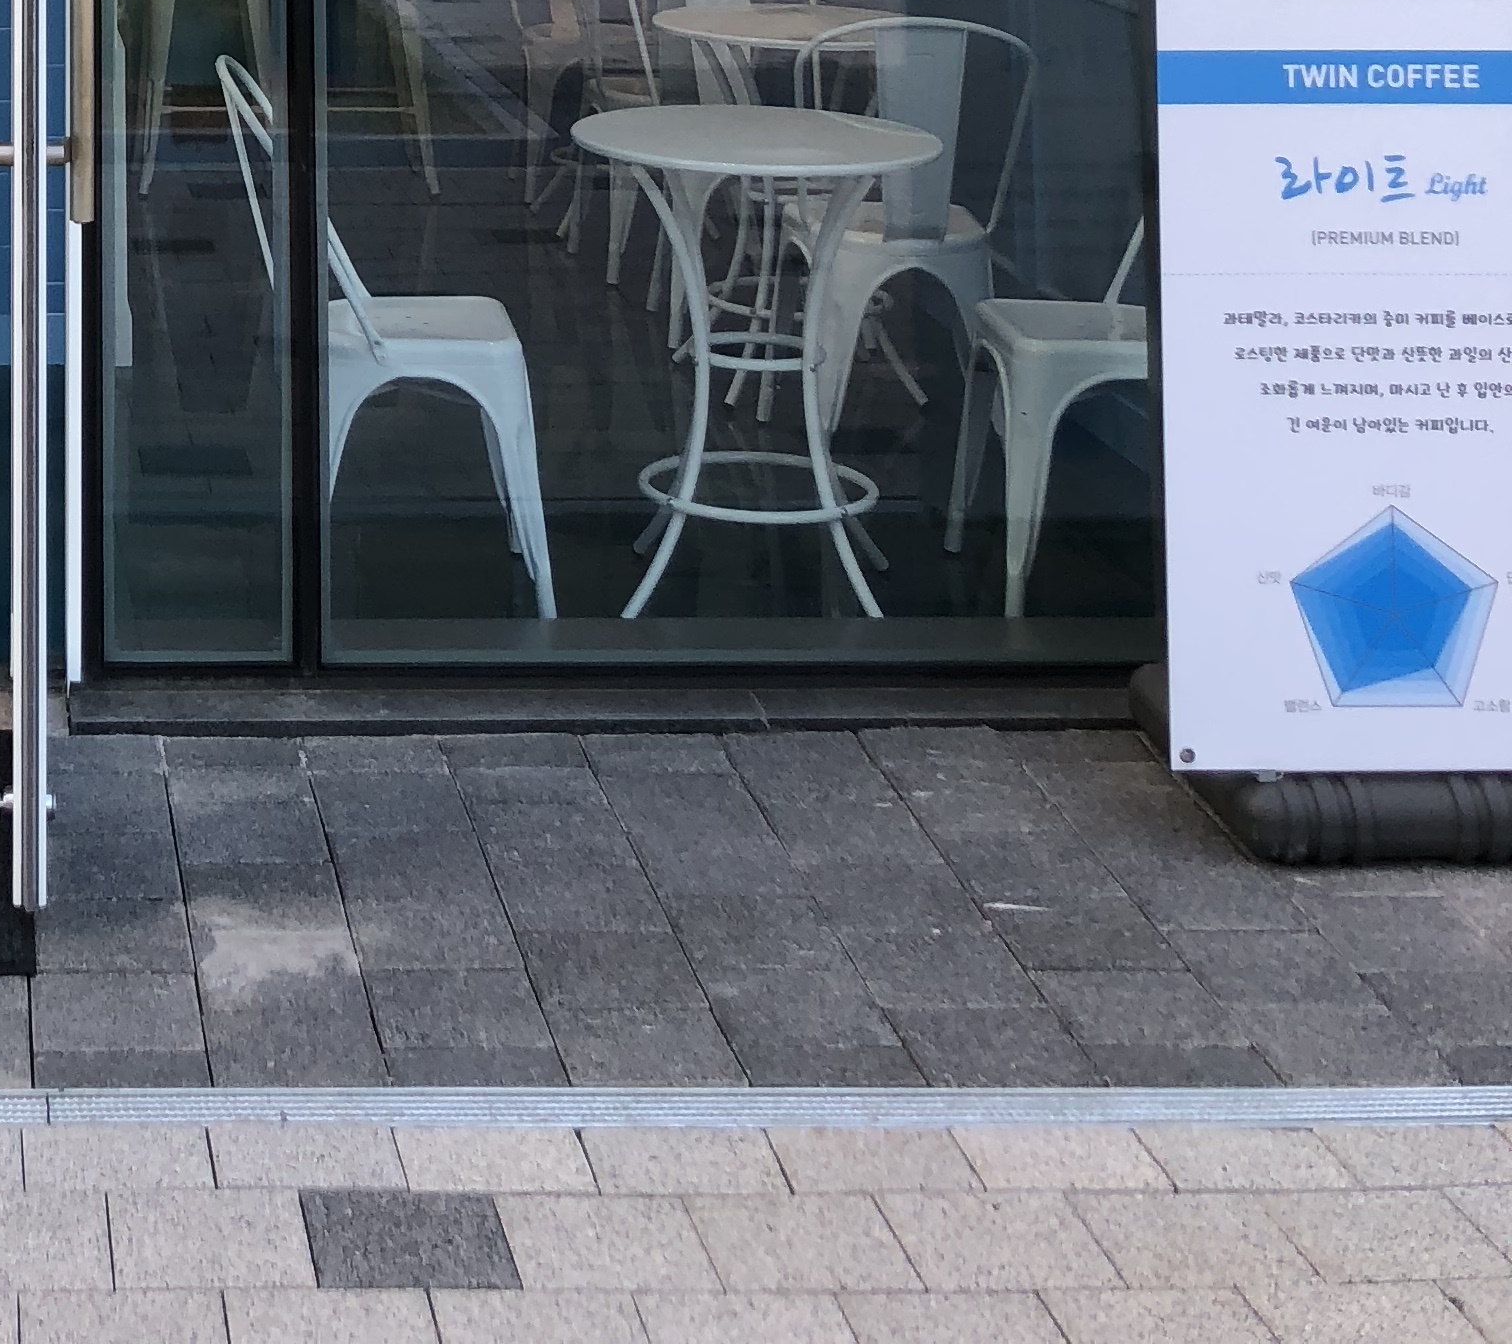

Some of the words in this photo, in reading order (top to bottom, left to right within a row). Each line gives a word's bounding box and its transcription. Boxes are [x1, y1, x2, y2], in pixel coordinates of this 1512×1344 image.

[1282, 64, 1358, 88] TWIN
[1367, 64, 1480, 89] COFFEE
[1274, 154, 1416, 204] 라이트
[1424, 172, 1487, 203] Light
